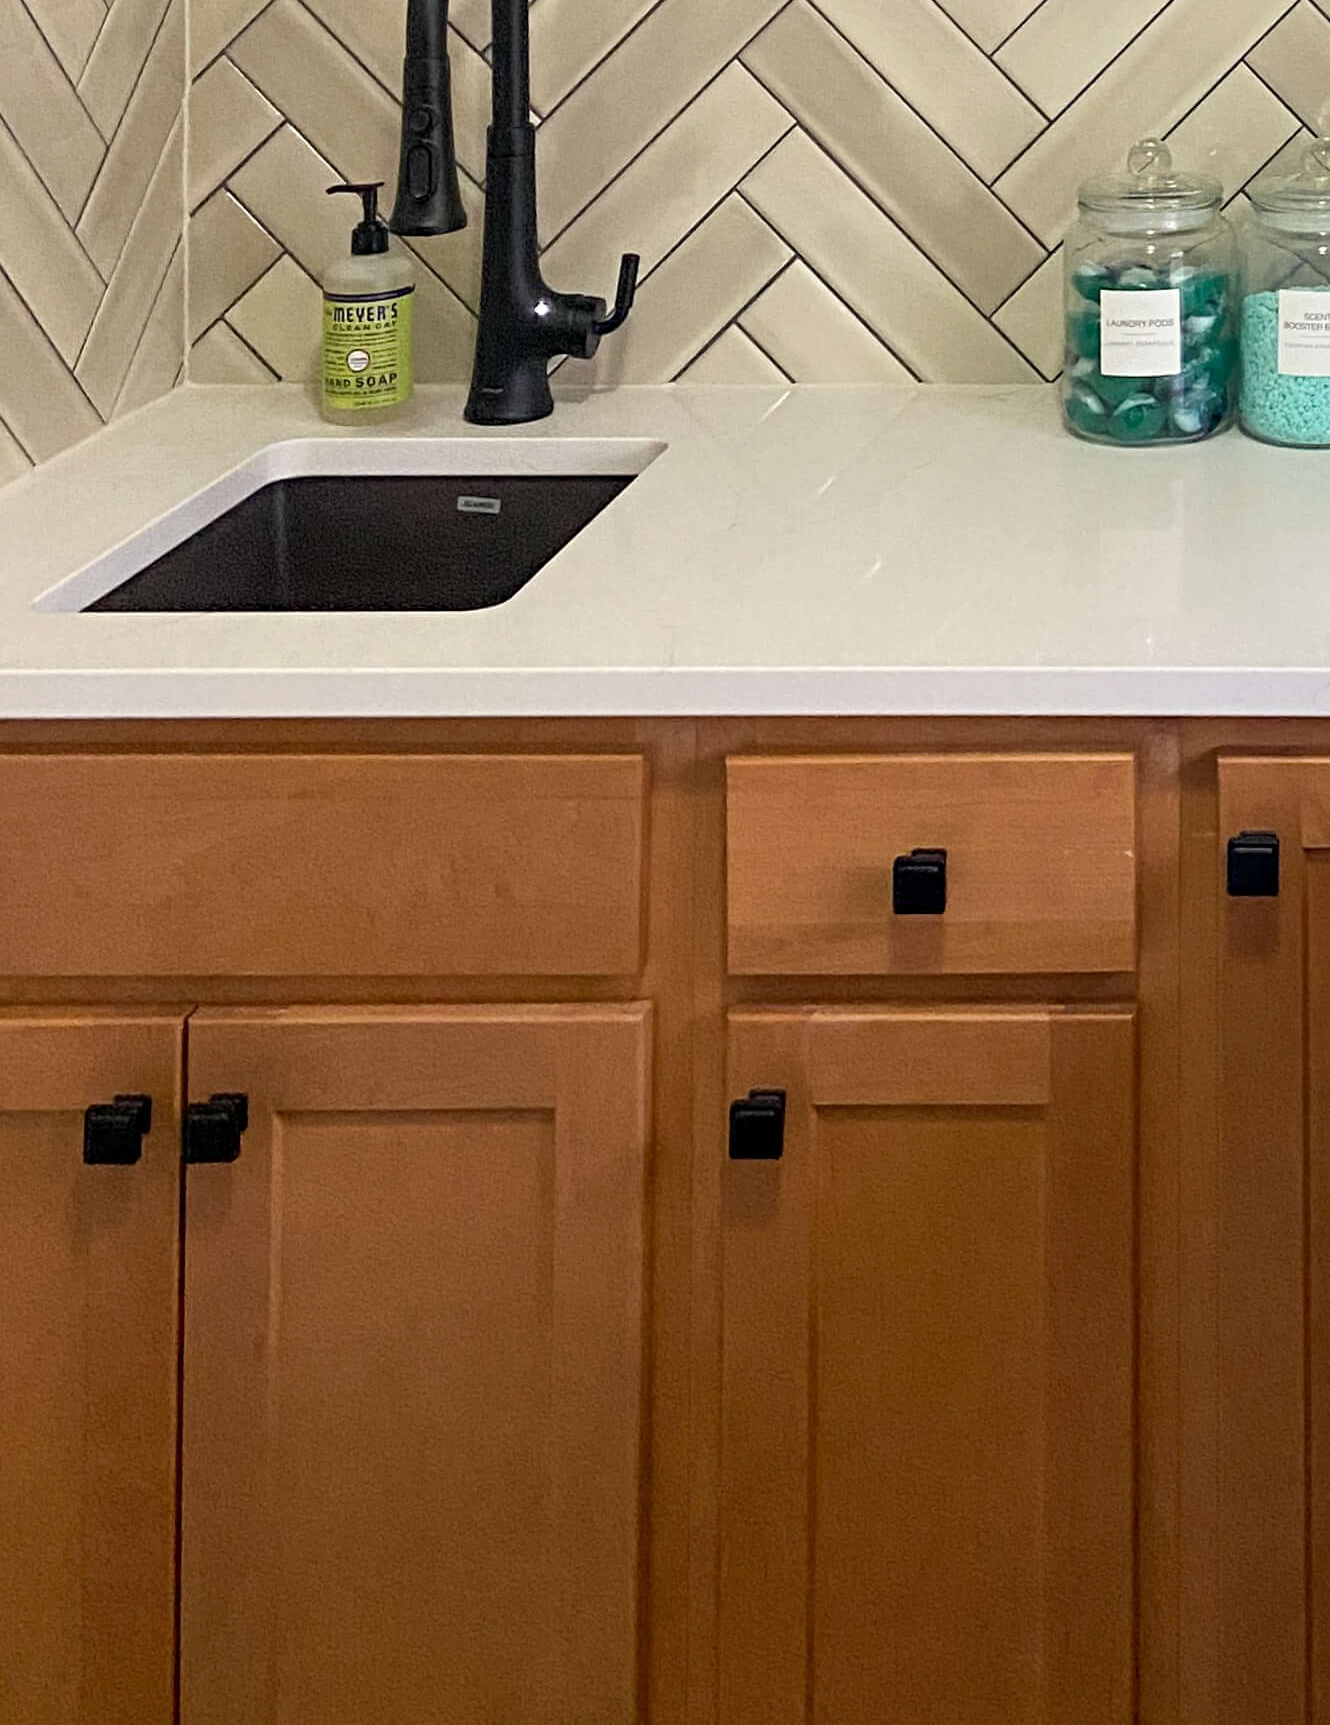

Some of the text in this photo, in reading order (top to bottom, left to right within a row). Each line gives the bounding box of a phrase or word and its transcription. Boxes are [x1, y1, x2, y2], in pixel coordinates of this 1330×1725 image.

[333, 302, 398, 323] MEYER'S
[332, 323, 371, 331] CLEAN
[1106, 318, 1175, 328] LAUNDRY PODS
[1283, 321, 1324, 331] BOOSTER
[355, 372, 398, 388] SOAP
